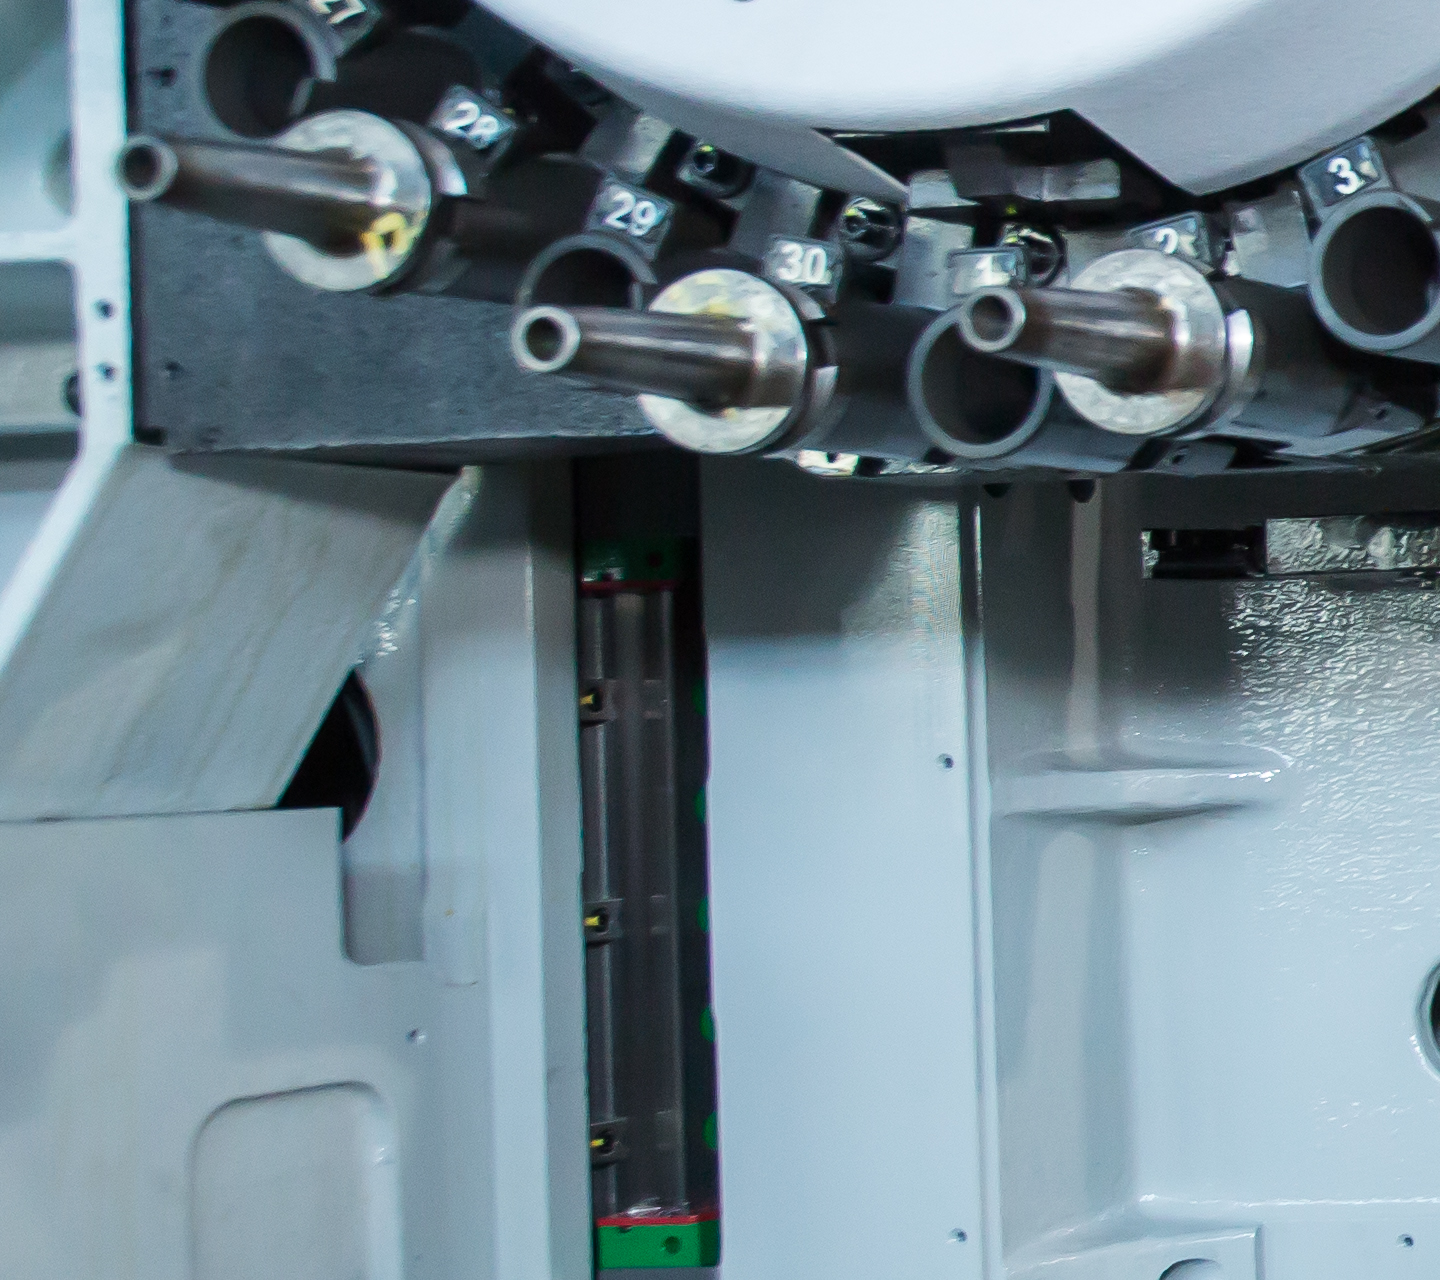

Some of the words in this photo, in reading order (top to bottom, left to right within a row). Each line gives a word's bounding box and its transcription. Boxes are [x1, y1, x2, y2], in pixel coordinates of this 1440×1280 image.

[1327, 157, 1359, 195] 3
[605, 190, 664, 237] 29
[776, 240, 829, 285] 30
